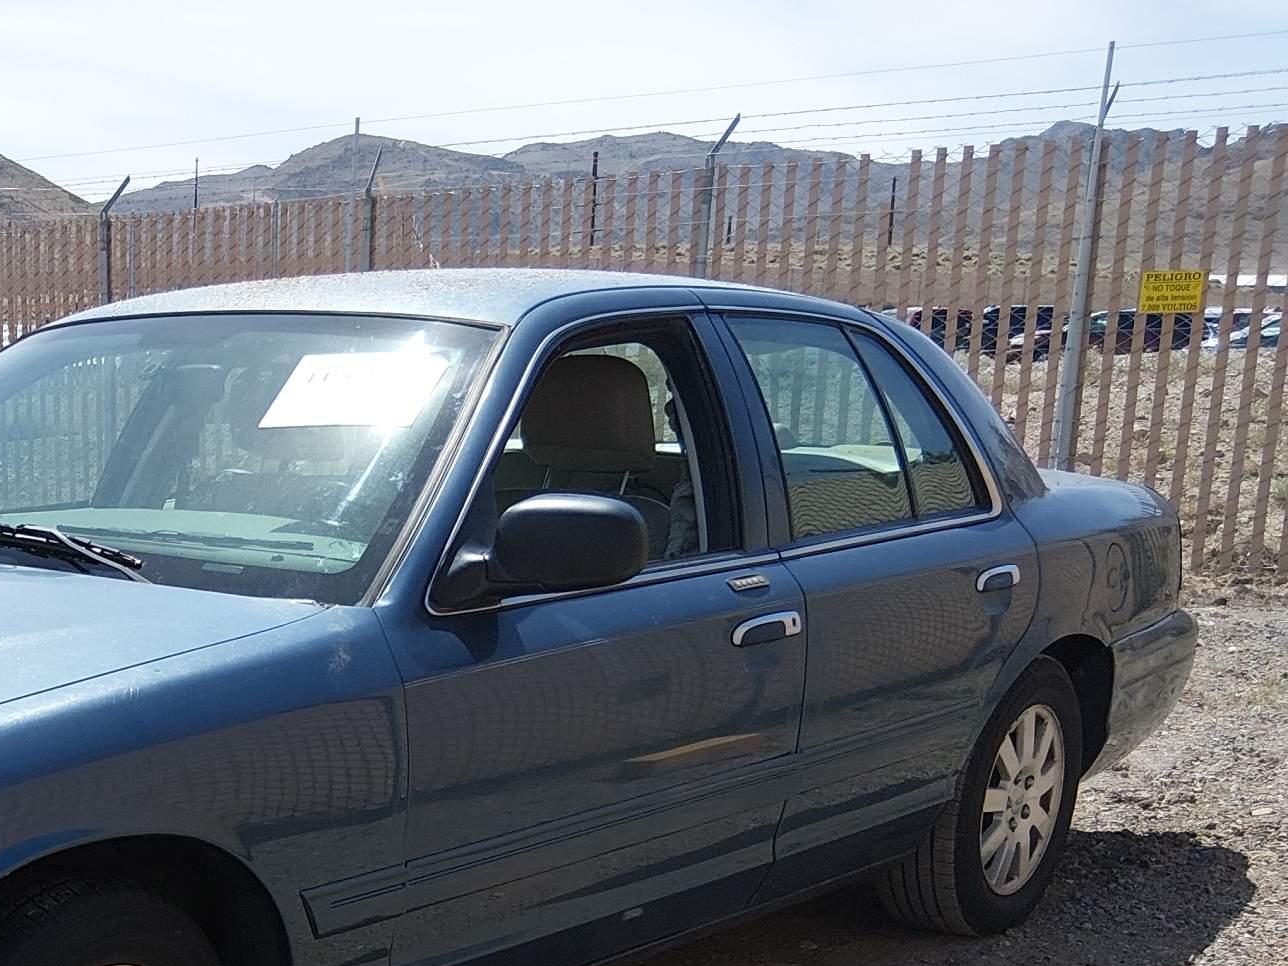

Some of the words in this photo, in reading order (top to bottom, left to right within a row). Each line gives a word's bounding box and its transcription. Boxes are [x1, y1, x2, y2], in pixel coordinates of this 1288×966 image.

[1145, 272, 1202, 282] PELIGRO
[1152, 284, 1164, 292] NO
[1165, 283, 1192, 292] TOQUE
[1145, 294, 1155, 302] de
[1155, 294, 1169, 302] alta
